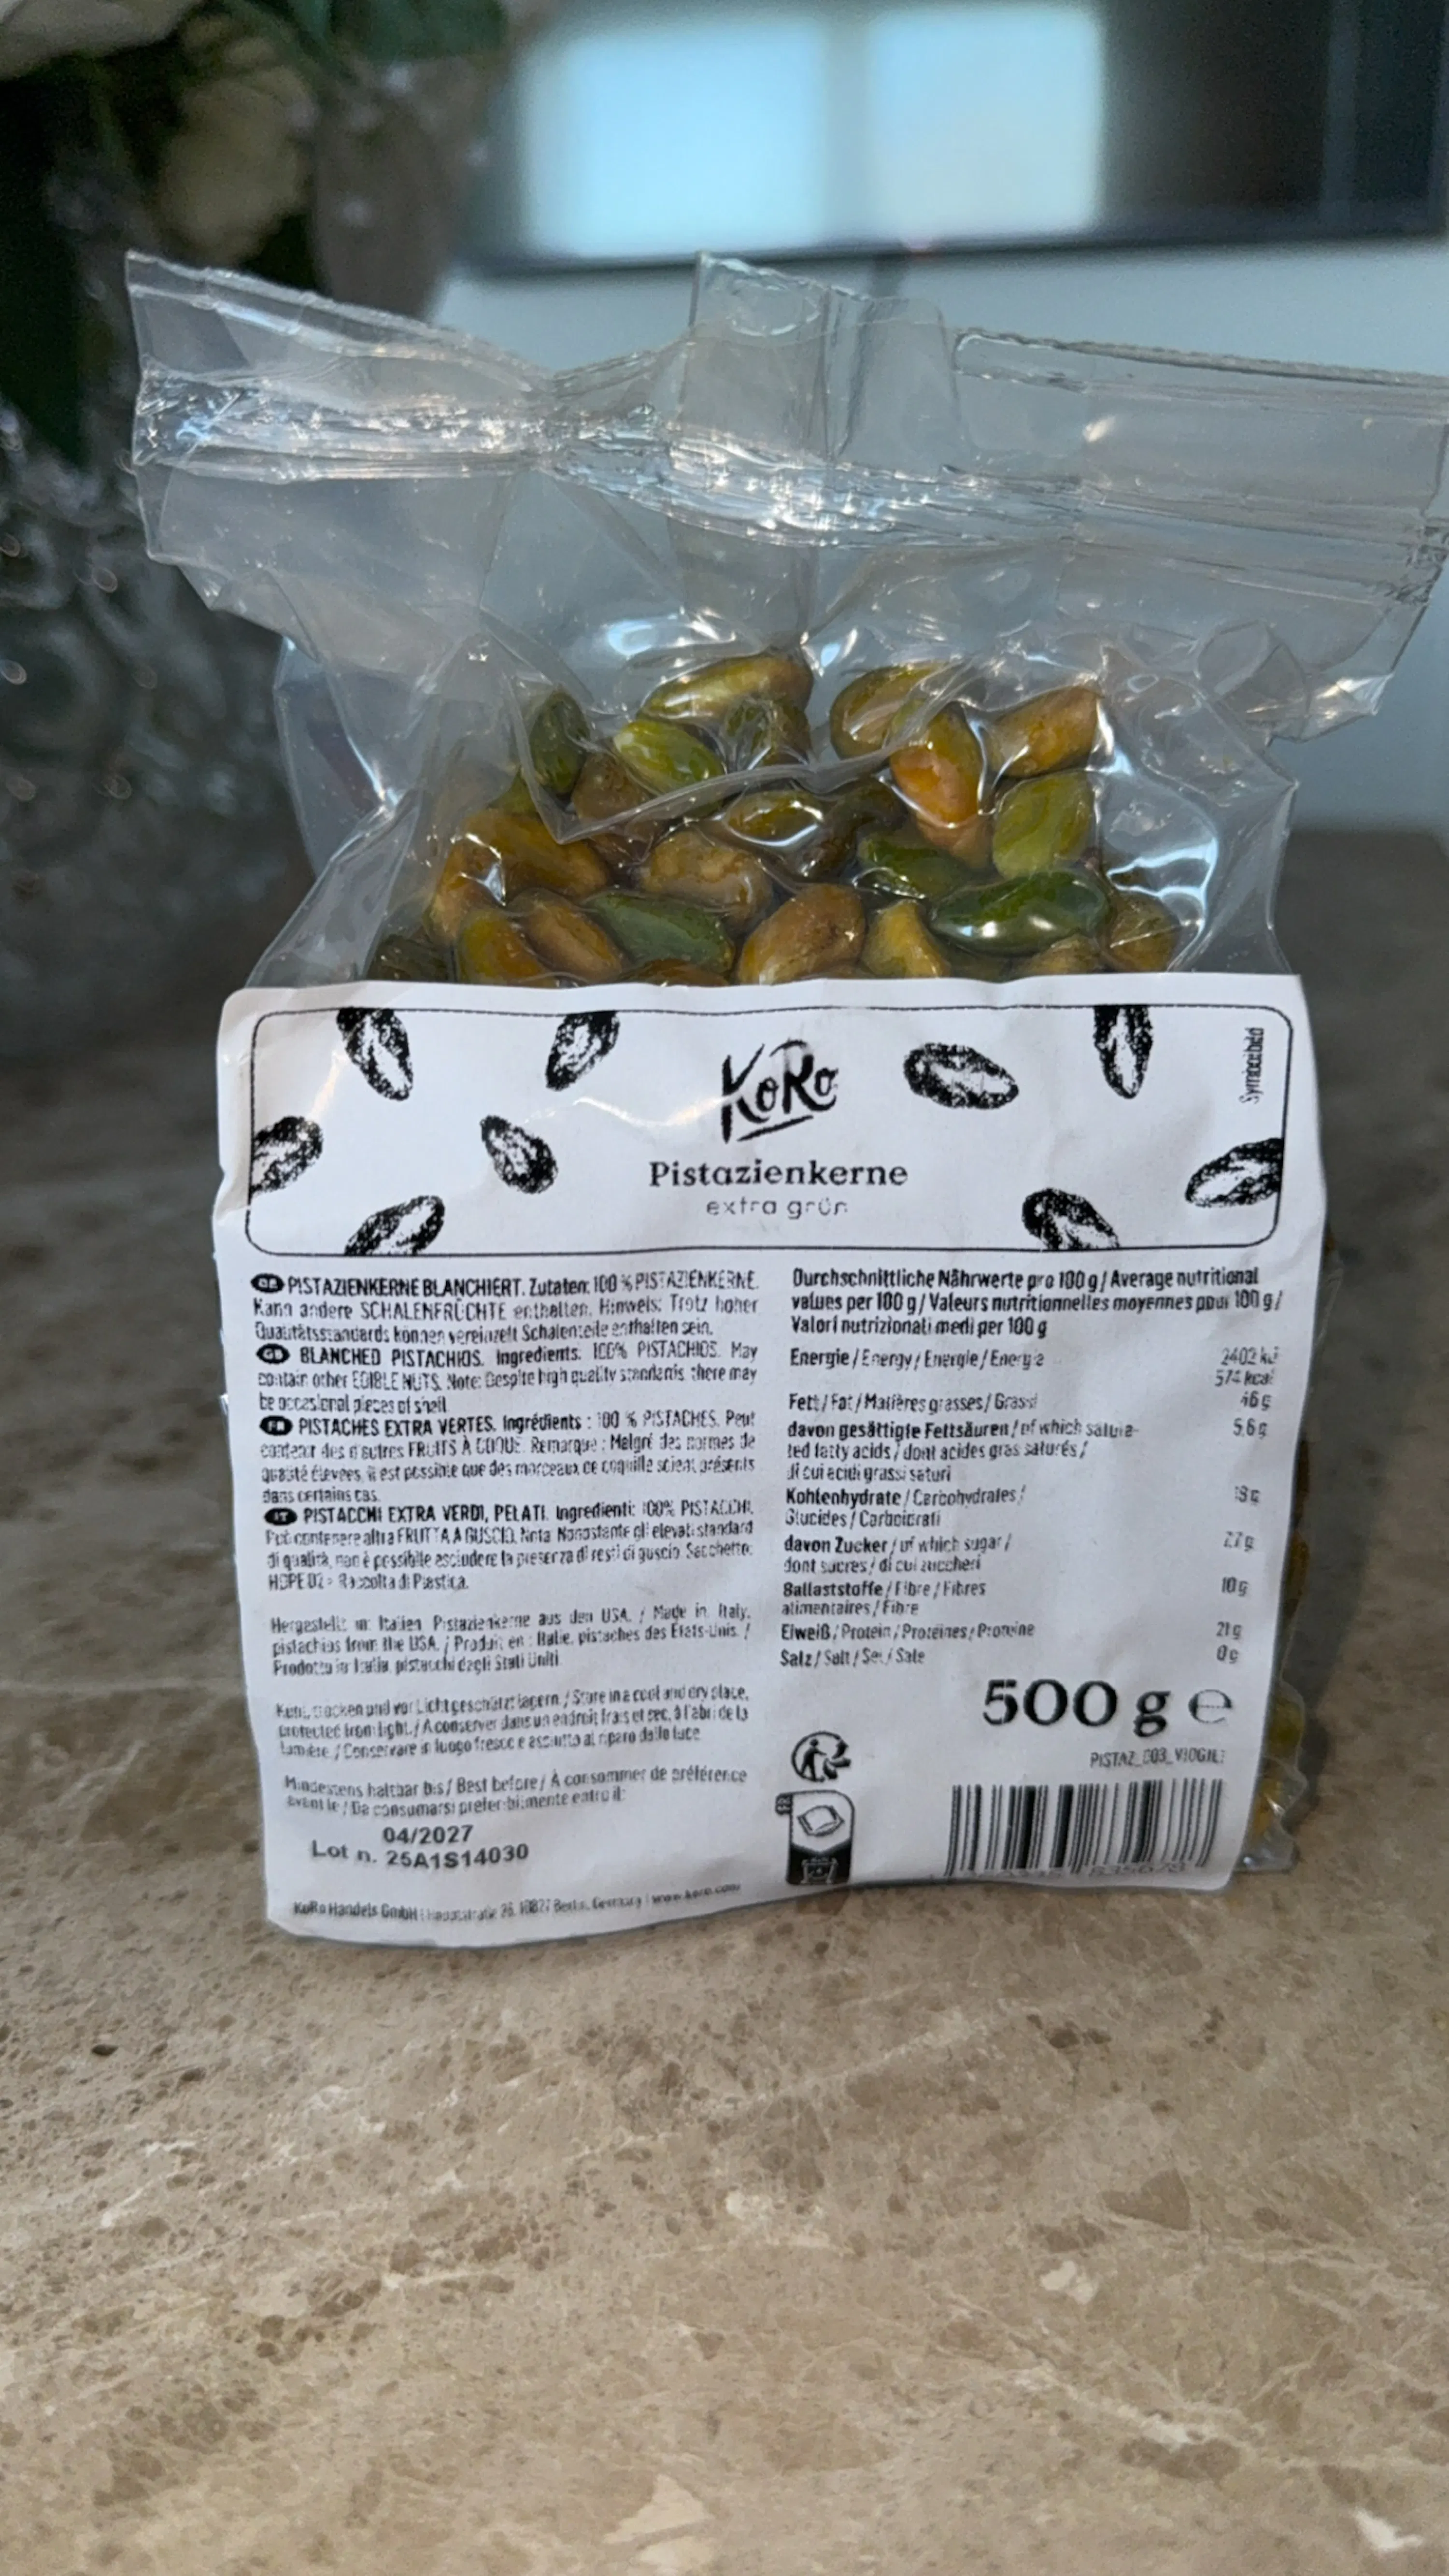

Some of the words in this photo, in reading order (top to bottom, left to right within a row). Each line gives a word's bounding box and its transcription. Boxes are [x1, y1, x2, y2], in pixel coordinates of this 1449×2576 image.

[719, 1038, 839, 1144] KoRo
[649, 1158, 908, 1187] Pistazienkerne
[707, 1196, 777, 1215] extra
[287, 1275, 420, 1297] PISTAZIENKERNE
[422, 1277, 526, 1299] BLANCHIERT.
[594, 1273, 617, 1294] 100
[793, 1267, 935, 1289] Durchschnittliche
[938, 1268, 1024, 1290] Nährwerte
[1027, 1274, 1055, 1293] pro
[1059, 1269, 1086, 1290] 100
[1087, 1274, 1098, 1294] g
[1110, 1269, 1174, 1292] Average
[1177, 1267, 1259, 1287] nutritional
[791, 1292, 843, 1311] values
[846, 1295, 874, 1315] per
[876, 1291, 904, 1312] 100
[907, 1296, 917, 1316] g
[929, 1292, 989, 1312] Valeurs
[992, 1292, 1110, 1313] nutritionnelles
[1112, 1295, 1193, 1314] moyennes
[1234, 1288, 1260, 1309] 100
[1263, 1293, 1274, 1312] g
[791, 1314, 838, 1334] Valori
[934, 1316, 975, 1336] medi
[977, 1320, 1004, 1339] per
[1008, 1316, 1035, 1336] 100
[1037, 1320, 1048, 1339] g
[299, 1346, 381, 1366] BLANCHED
[731, 1341, 758, 1363] May
[790, 1347, 850, 1370] Energie
[862, 1348, 912, 1371] Energy
[924, 1349, 979, 1370] Energie
[928, 1396, 983, 1415] grasses
[298, 1417, 380, 1437] PISTACHES
[384, 1419, 433, 1438] EXTRA
[437, 1415, 497, 1436] VERTES.
[787, 1420, 835, 1438] davon
[838, 1420, 922, 1443] gesättigte
[924, 1421, 1009, 1439] Fettsäuren
[1039, 1418, 1082, 1435] which
[787, 1441, 810, 1459] ted
[940, 1441, 985, 1461] acides
[989, 1444, 1020, 1461] gras
[786, 1487, 901, 1510] Kohlenhydrate
[303, 1506, 383, 1524] PISTACCHI
[388, 1505, 436, 1523] EXTRA
[442, 1504, 489, 1523] VERDI,
[453, 1526, 462, 1544] A
[784, 1534, 831, 1553] davon
[835, 1536, 888, 1554] Zucker
[964, 1537, 1002, 1554] sugar
[783, 1580, 883, 1597] Ballaststoffe
[1222, 1577, 1237, 1594] 10
[781, 1599, 870, 1615] alimentaires
[781, 1623, 831, 1641] Eiweiß
[1217, 1622, 1230, 1637] 21
[1233, 1625, 1242, 1640] g
[780, 1648, 812, 1667] Salz
[824, 1649, 850, 1666] Salt
[896, 1647, 925, 1664] Sale
[1217, 1645, 1228, 1662] 0
[982, 1679, 1119, 1728] 500
[1133, 1691, 1171, 1739] g
[456, 1777, 487, 1794] Best
[382, 1824, 473, 1846] 04/2027
[311, 1840, 348, 1859] Lot
[357, 1850, 377, 1863] n.
[386, 1840, 529, 1870] 25A1S14030
